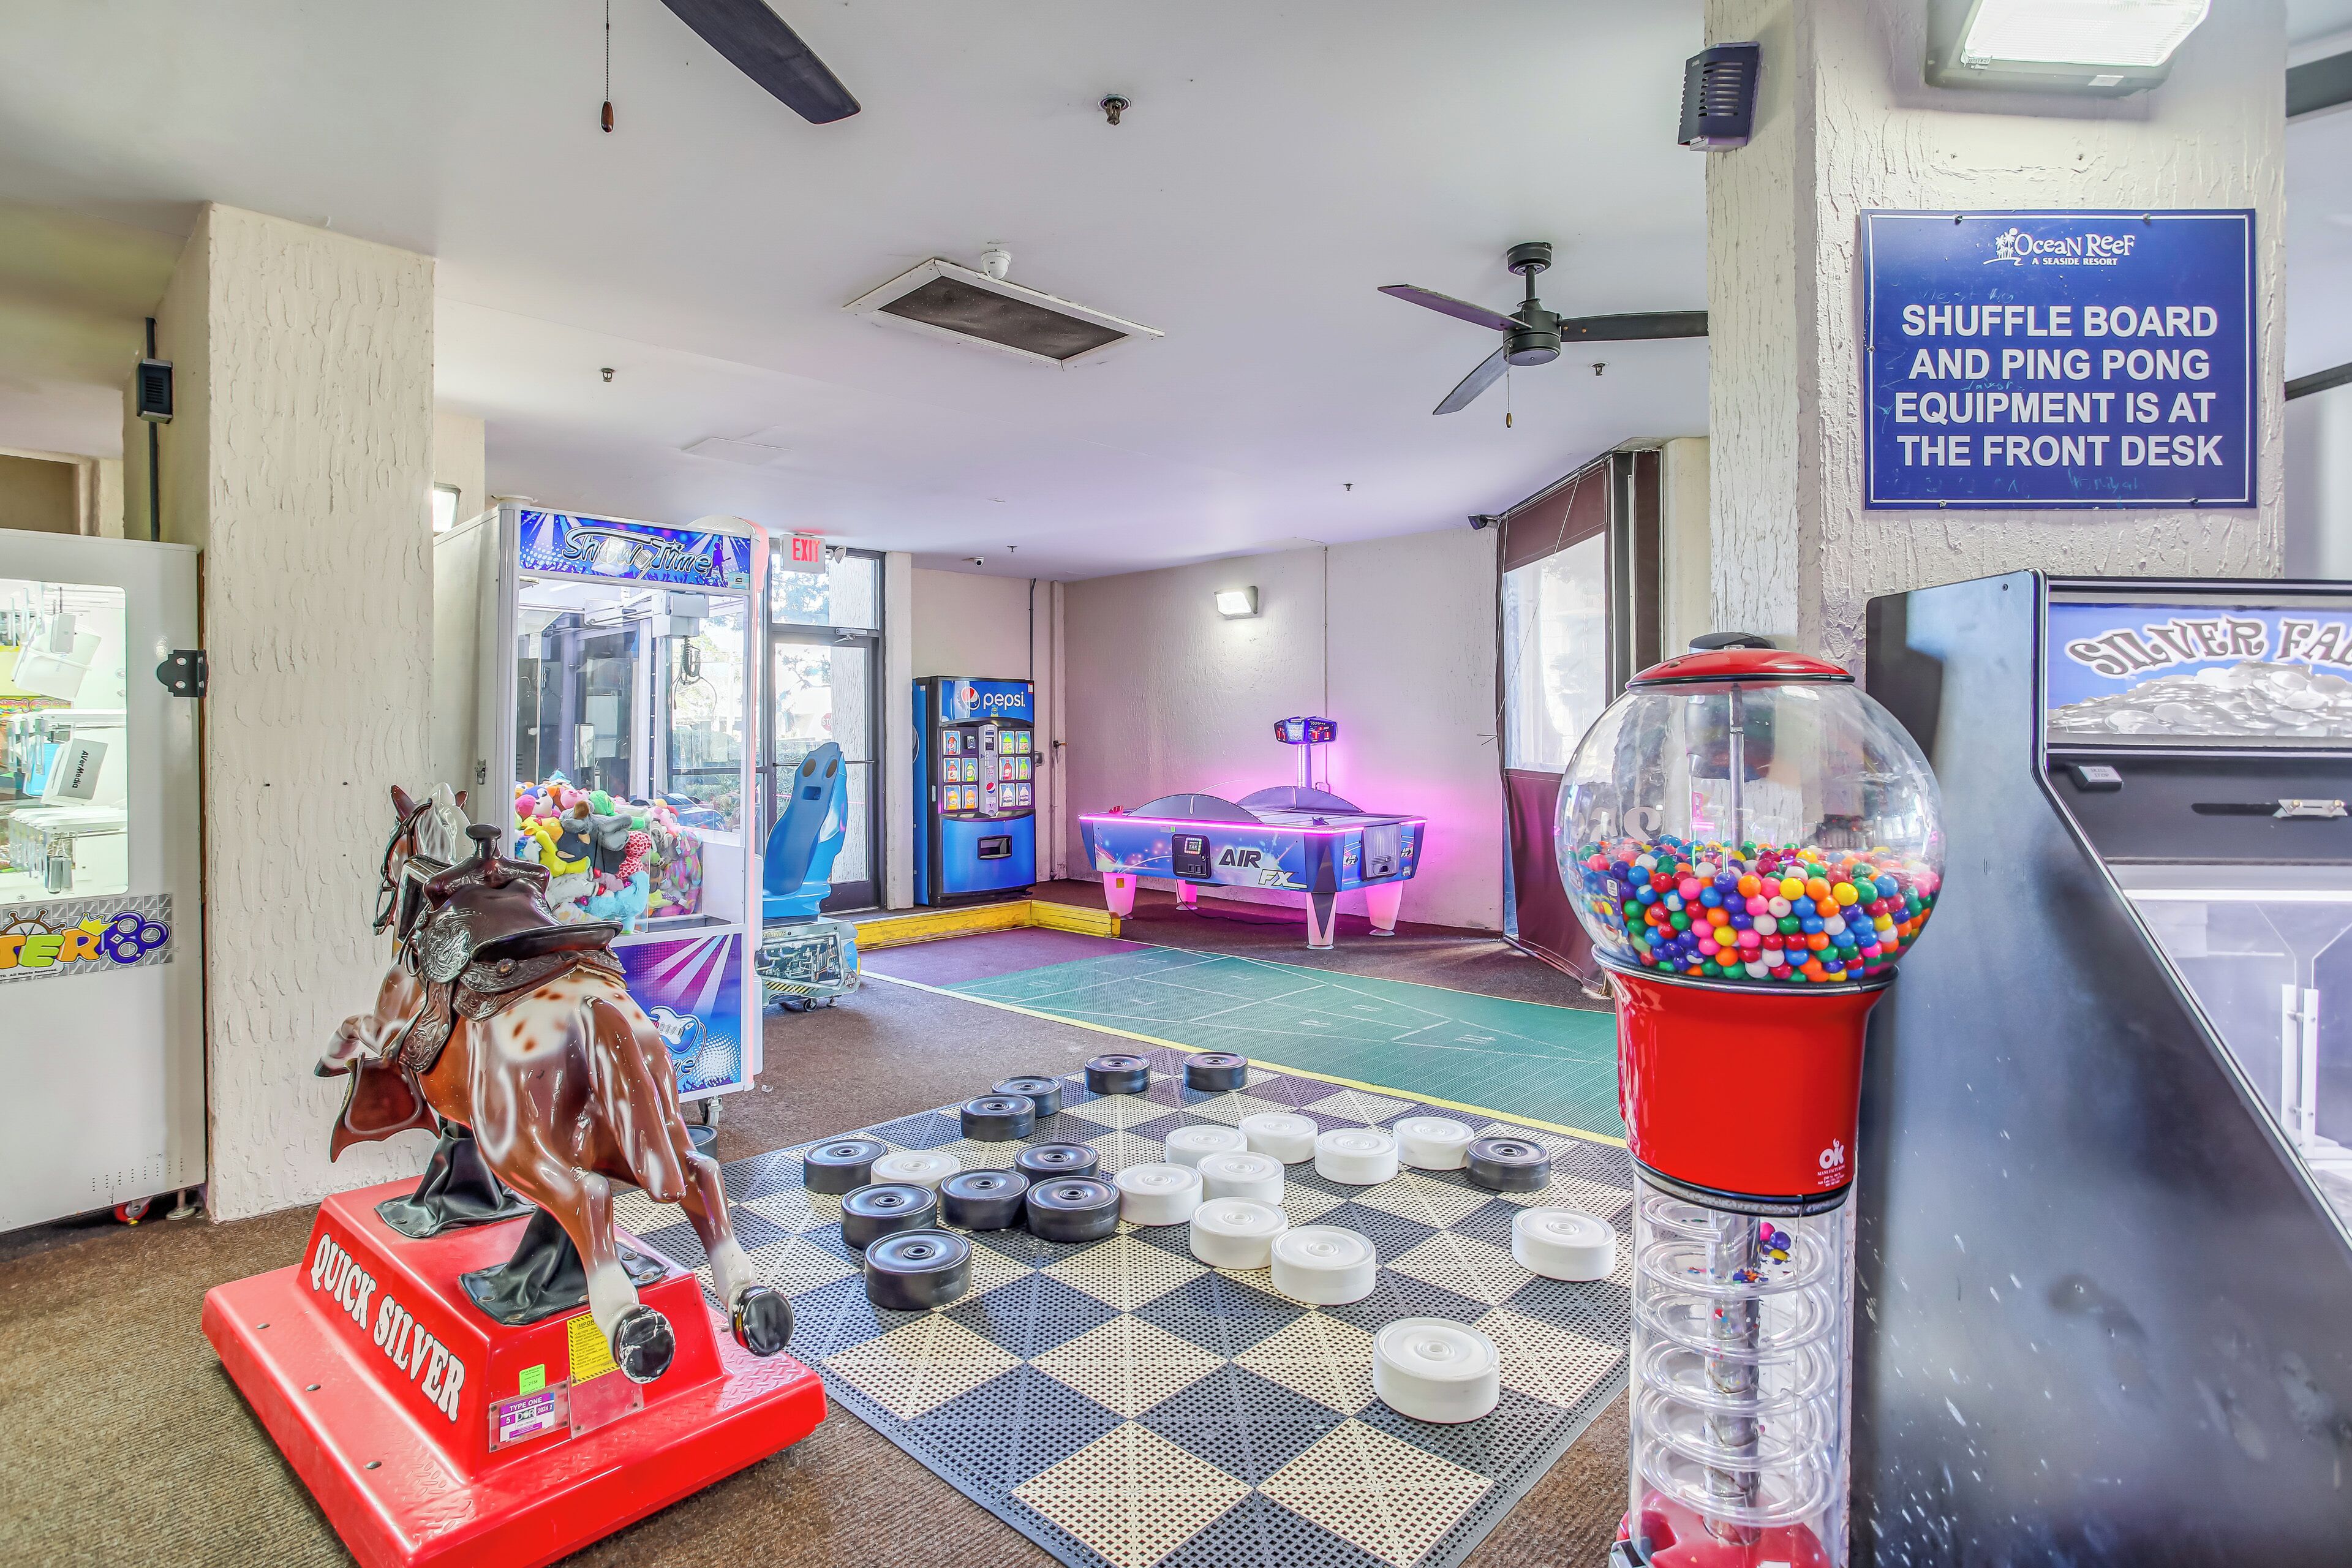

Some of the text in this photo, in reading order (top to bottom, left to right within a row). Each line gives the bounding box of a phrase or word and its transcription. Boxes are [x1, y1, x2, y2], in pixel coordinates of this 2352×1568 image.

[2082, 257, 2118, 266] RESORT
[1902, 304, 2218, 337] SHUFFLE BOARD
[1908, 349, 2210, 380] AND PING PONG
[1895, 392, 2217, 426] EQUIPMENT IS AT
[1896, 435, 2223, 467] THE FRONT DESK
[792, 537, 820, 564] EXIT
[2068, 616, 2265, 675] SILVER
[982, 691, 1025, 710] pepsi
[72, 750, 89, 789] AVerMedia
[1219, 848, 1262, 869] AIR
[1258, 869, 1307, 889] FX
[310, 1232, 466, 1423] QUICK SILVER
[510, 1396, 543, 1412] TYPE ONE
[537, 1406, 549, 1414] 2024
